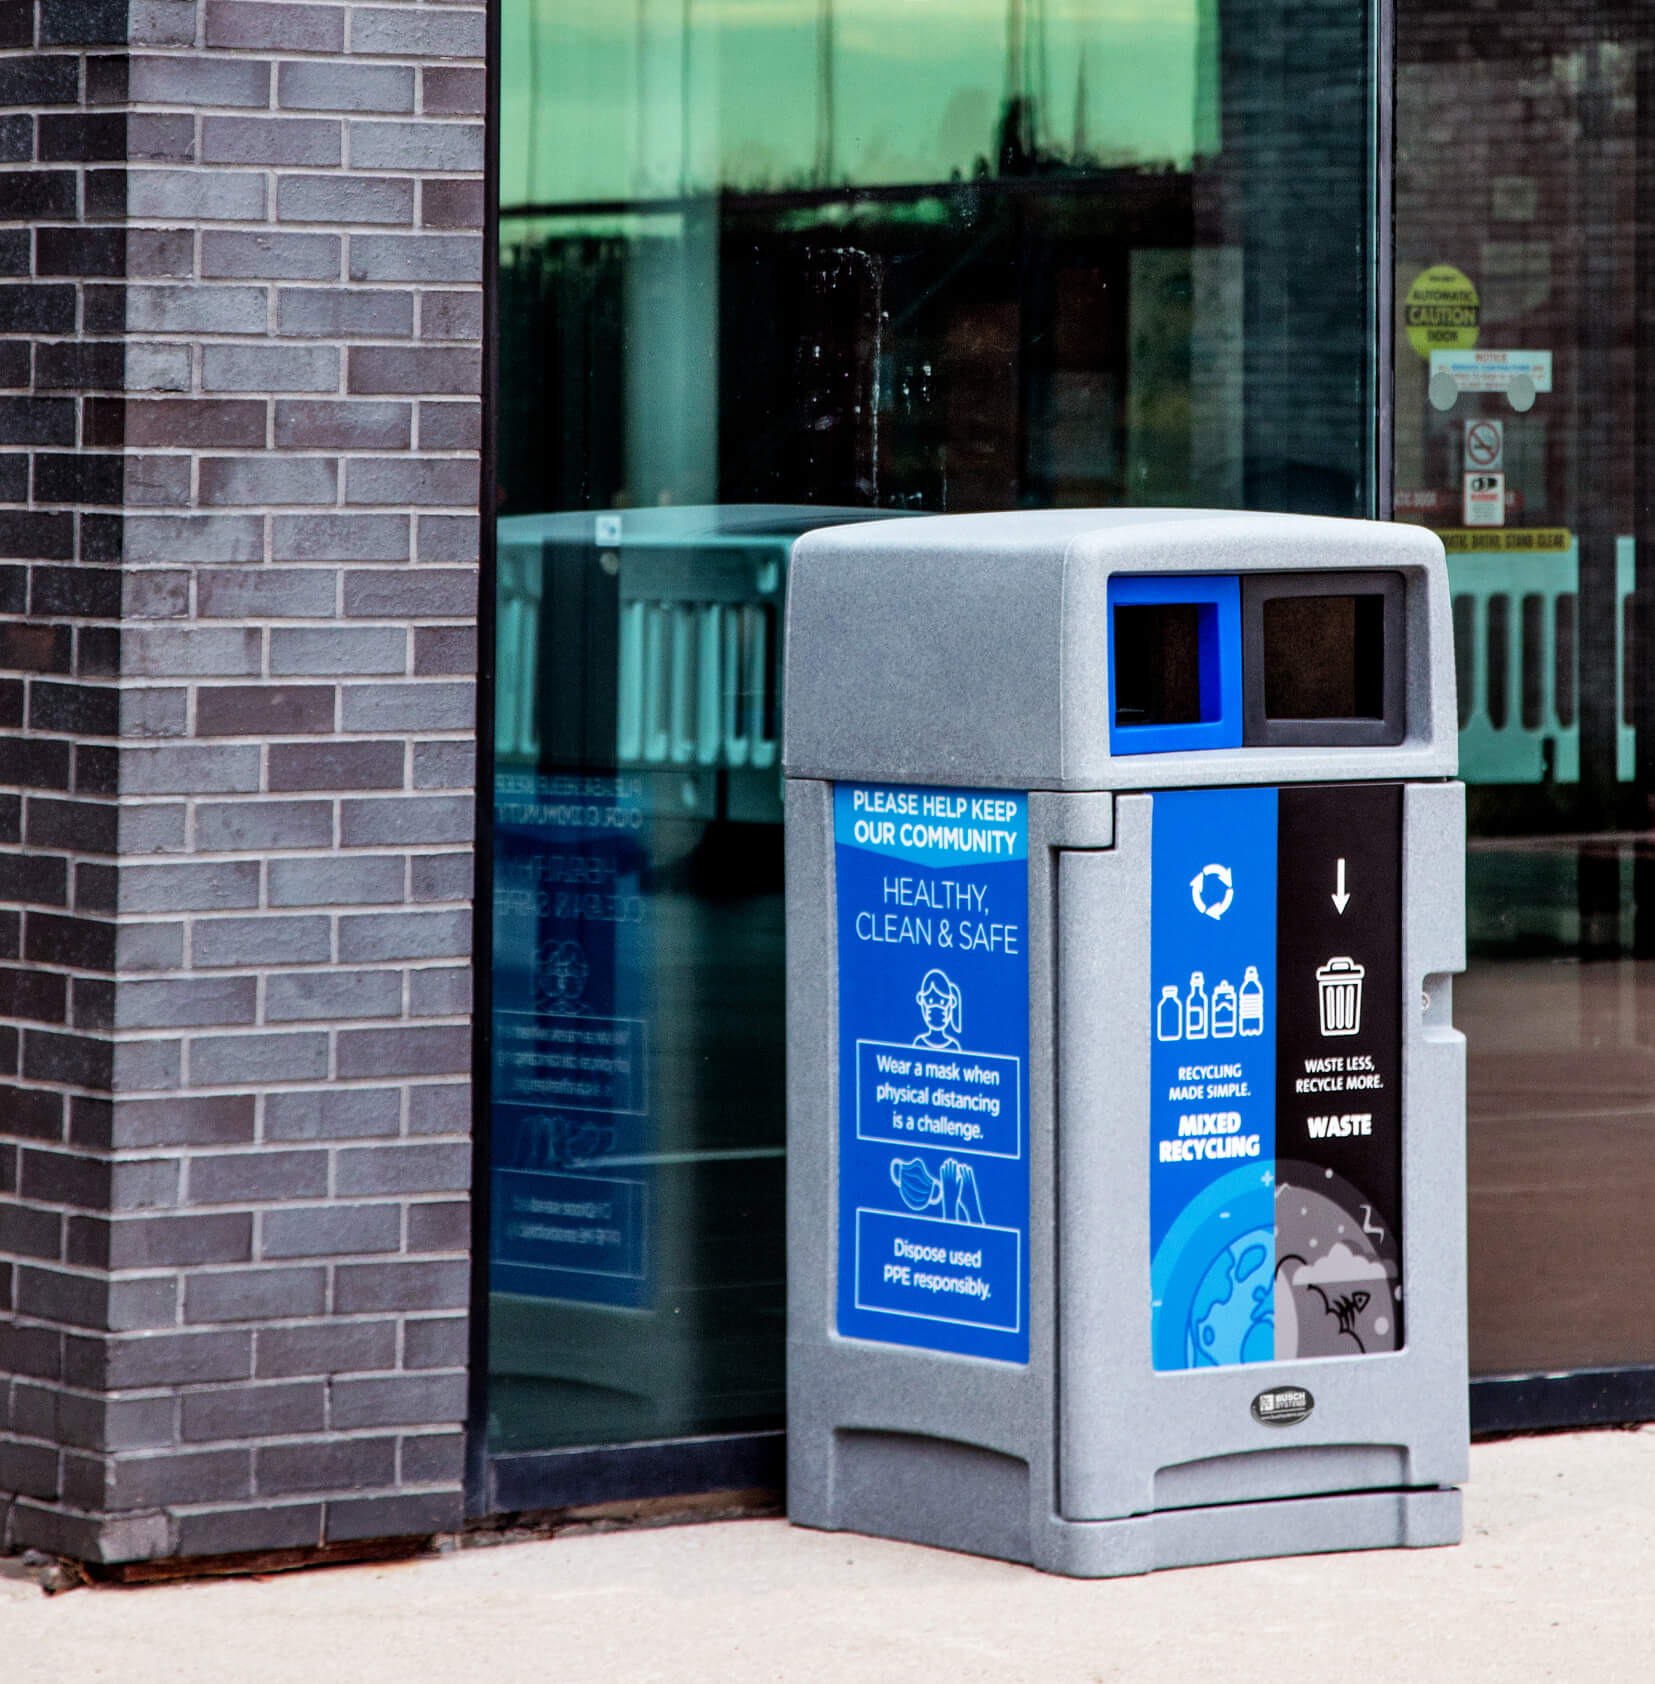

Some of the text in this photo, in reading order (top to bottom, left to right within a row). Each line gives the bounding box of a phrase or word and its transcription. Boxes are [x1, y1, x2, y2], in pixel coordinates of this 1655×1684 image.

[1409, 307, 1476, 326] CAUTION
[854, 790, 1017, 822] PLEASE HELP KEEP
[854, 820, 1017, 854] OUR COMMUNITY
[884, 876, 989, 916] HEALTHY,
[856, 912, 1018, 955] CLEAN & SAFE
[876, 1054, 1000, 1086] Wear a mask when
[1178, 1062, 1242, 1081] RECYCLING
[1304, 1055, 1376, 1073] WASTE LESS,
[1168, 1081, 1252, 1101] MADE SIMPLE.
[1296, 1074, 1384, 1094] RECYCLE MORE.
[876, 1083, 1000, 1116] physical distancing
[892, 1111, 984, 1142] is a challenge.
[1178, 1111, 1241, 1136] MIXED
[1307, 1113, 1372, 1139] WASTE
[1158, 1134, 1260, 1163] RECYCLING
[894, 1238, 982, 1268] Dispose used
[884, 1264, 991, 1301] PPE responsibly.
[1275, 1392, 1305, 1403] BUSCH
